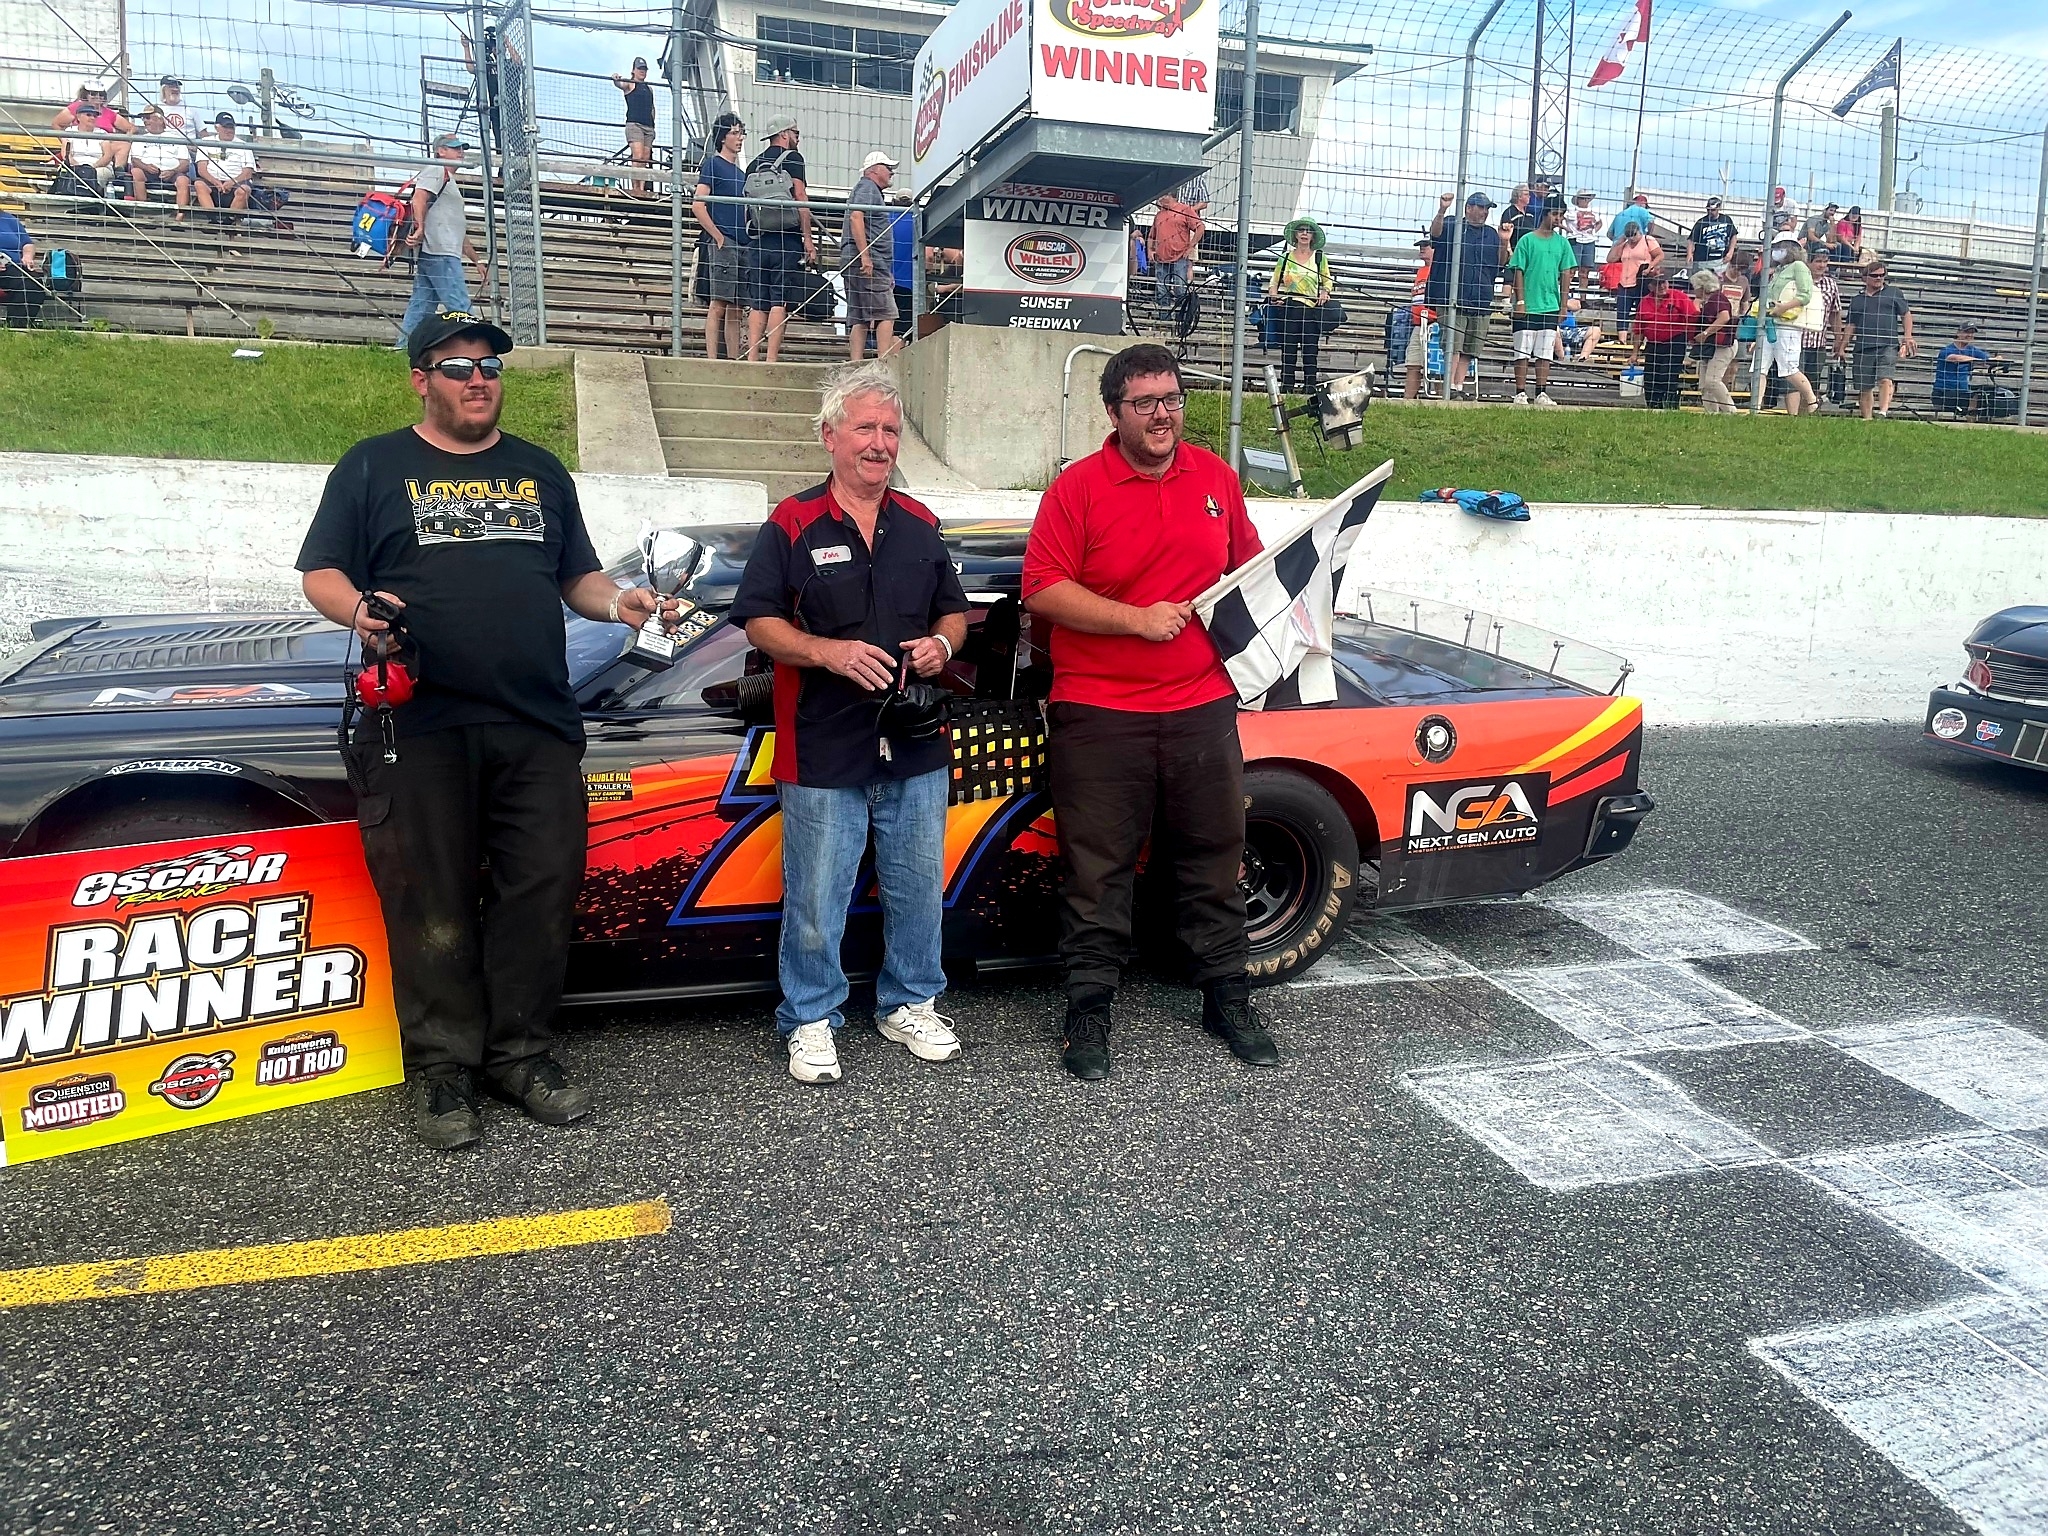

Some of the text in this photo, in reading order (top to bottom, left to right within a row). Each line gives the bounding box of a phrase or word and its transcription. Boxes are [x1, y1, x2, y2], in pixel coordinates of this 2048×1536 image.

[1077, 8, 1180, 38] Speedway
[948, 0, 1023, 104] FINISHLINE
[1040, 44, 1208, 93] WINNER
[1059, 190, 1115, 203] 2019 RACE
[358, 212, 376, 232] 24
[982, 197, 1109, 228] WINNER
[1036, 240, 1066, 252] NASCAR
[1019, 252, 1073, 266] WHELEN
[1022, 266, 1070, 274] ALL-AMERICAN
[1020, 296, 1073, 310] SUNSET
[1008, 316, 1082, 330] SPEEDWAY
[822, 551, 840, 560] John
[88, 694, 312, 708] NEXT GEN AUTO
[92, 682, 312, 703] NGA
[120, 759, 236, 775] AMERICAN
[587, 773, 614, 782] SAUBLE
[1409, 781, 1539, 837] NGA
[1407, 826, 1537, 850] NEXT GEN AUTO
[71, 852, 289, 908] OSCAAR
[115, 882, 243, 910] RACING
[1245, 861, 1352, 977] AMERICAN
[50, 898, 310, 993] RACE
[0, 949, 364, 1062] WINNER
[266, 1037, 333, 1056] Knightworks
[259, 1046, 345, 1083] HOT ROD
[34, 1080, 110, 1103] QUEENSTON
[152, 1070, 231, 1092] OSCAAR
[24, 1092, 123, 1128] MODIFIED
